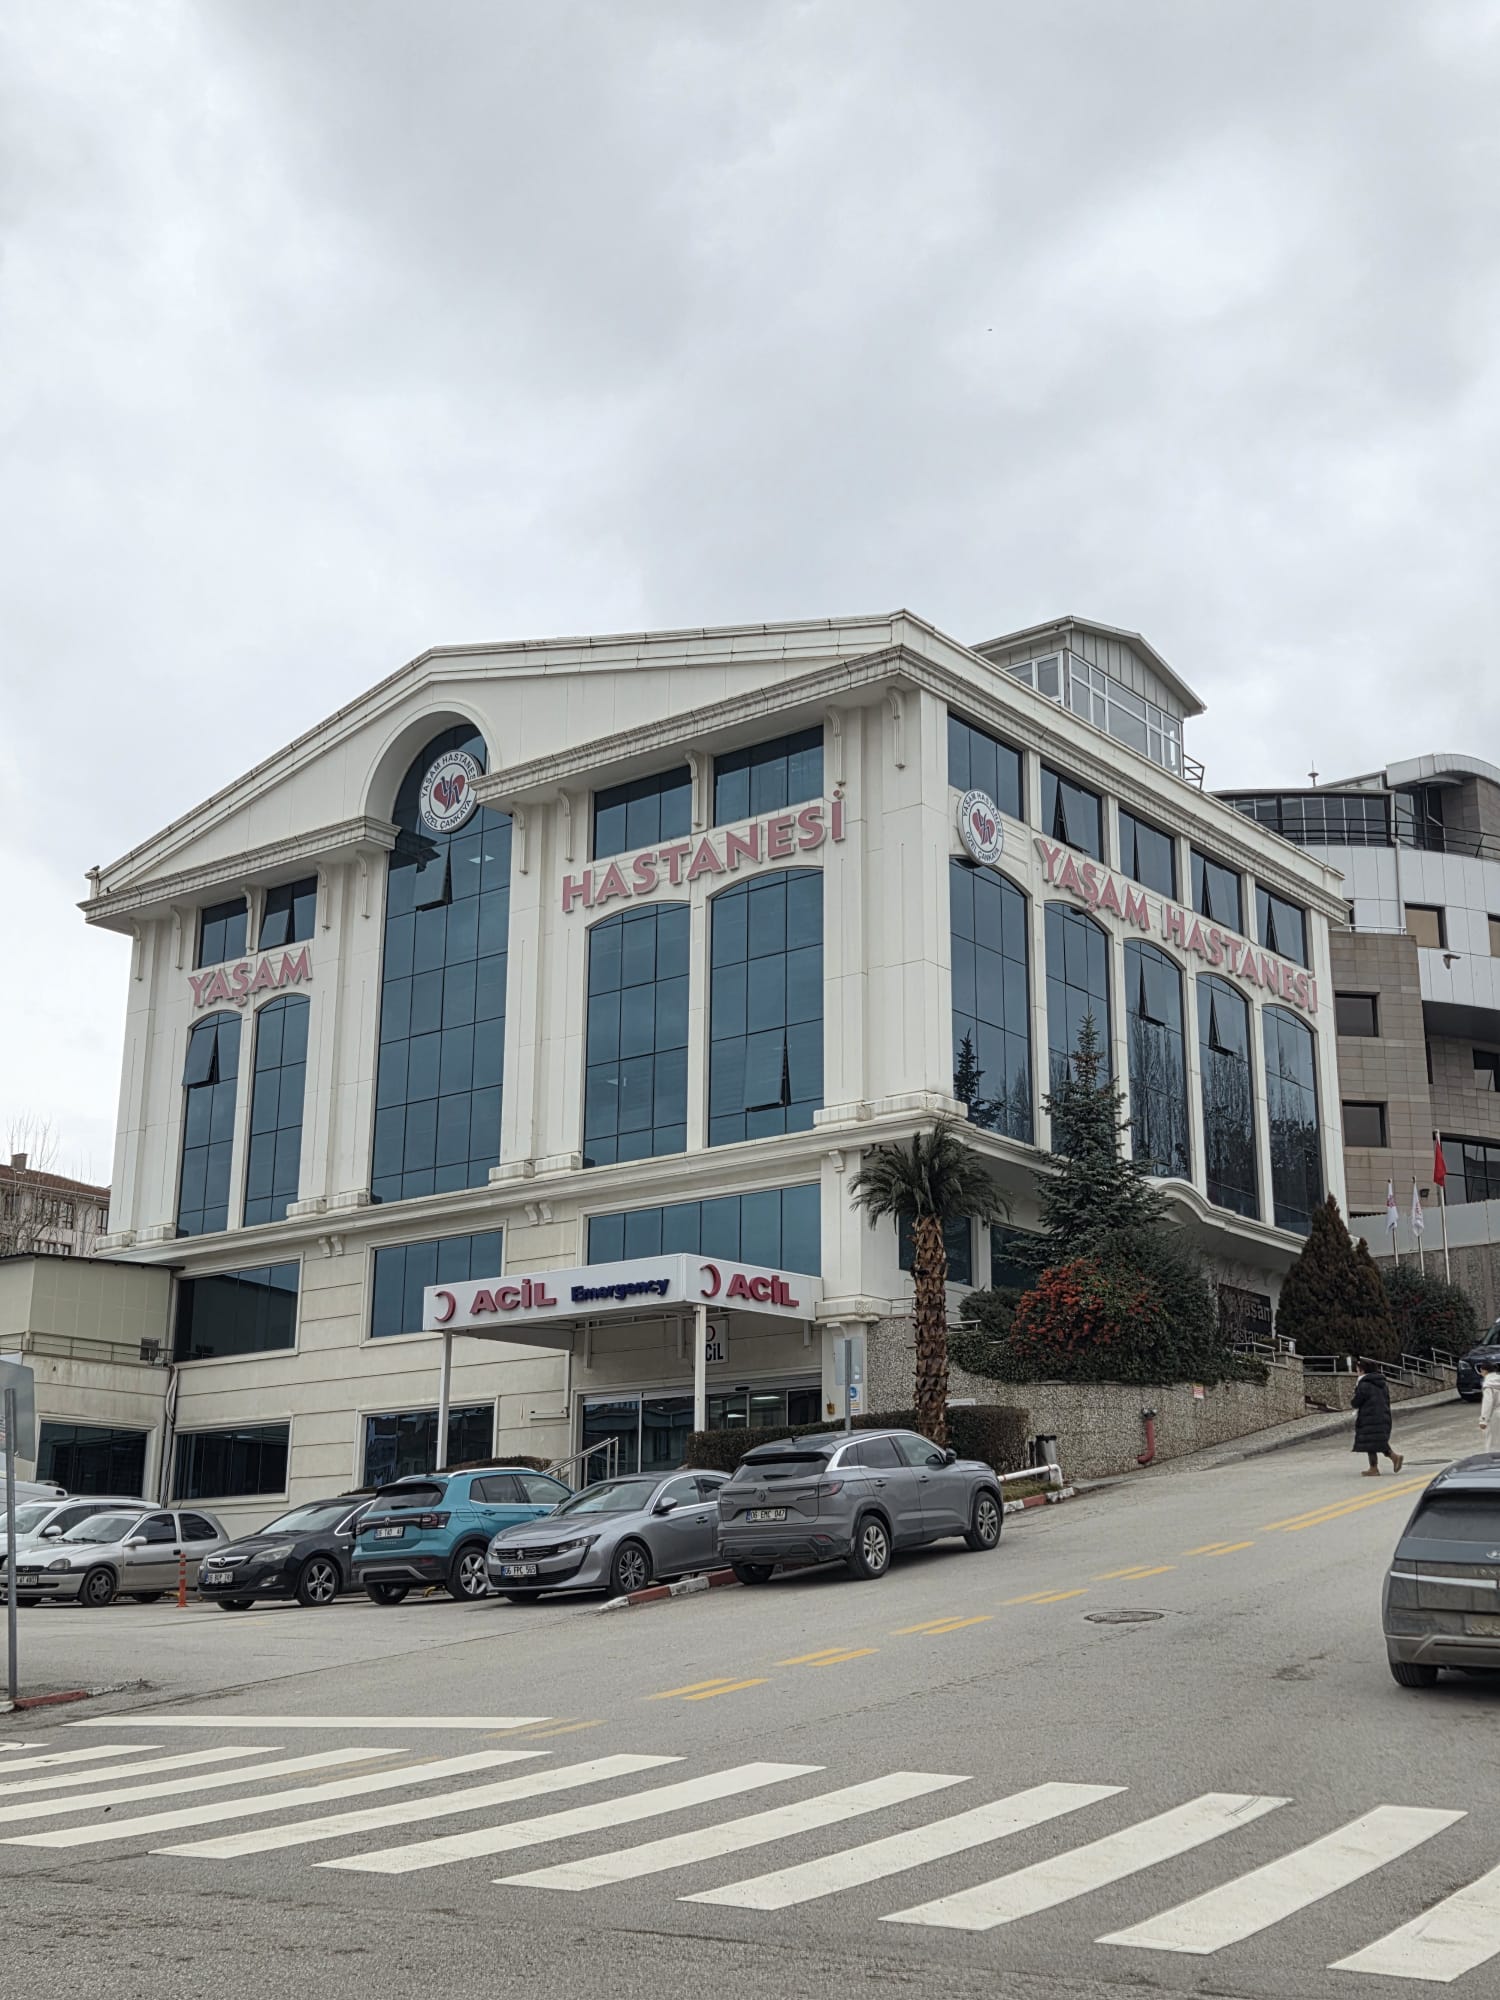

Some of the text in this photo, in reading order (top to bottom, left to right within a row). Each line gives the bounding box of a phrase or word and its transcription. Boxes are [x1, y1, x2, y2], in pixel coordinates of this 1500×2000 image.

[562, 789, 846, 913] HASTANESİ
[1034, 837, 1319, 1014] YAŞAM HASTANESİ
[187, 945, 313, 1008] YAŞAM
[470, 1277, 670, 1315] ACİL Emergency
[726, 1274, 800, 1307] ACİL
